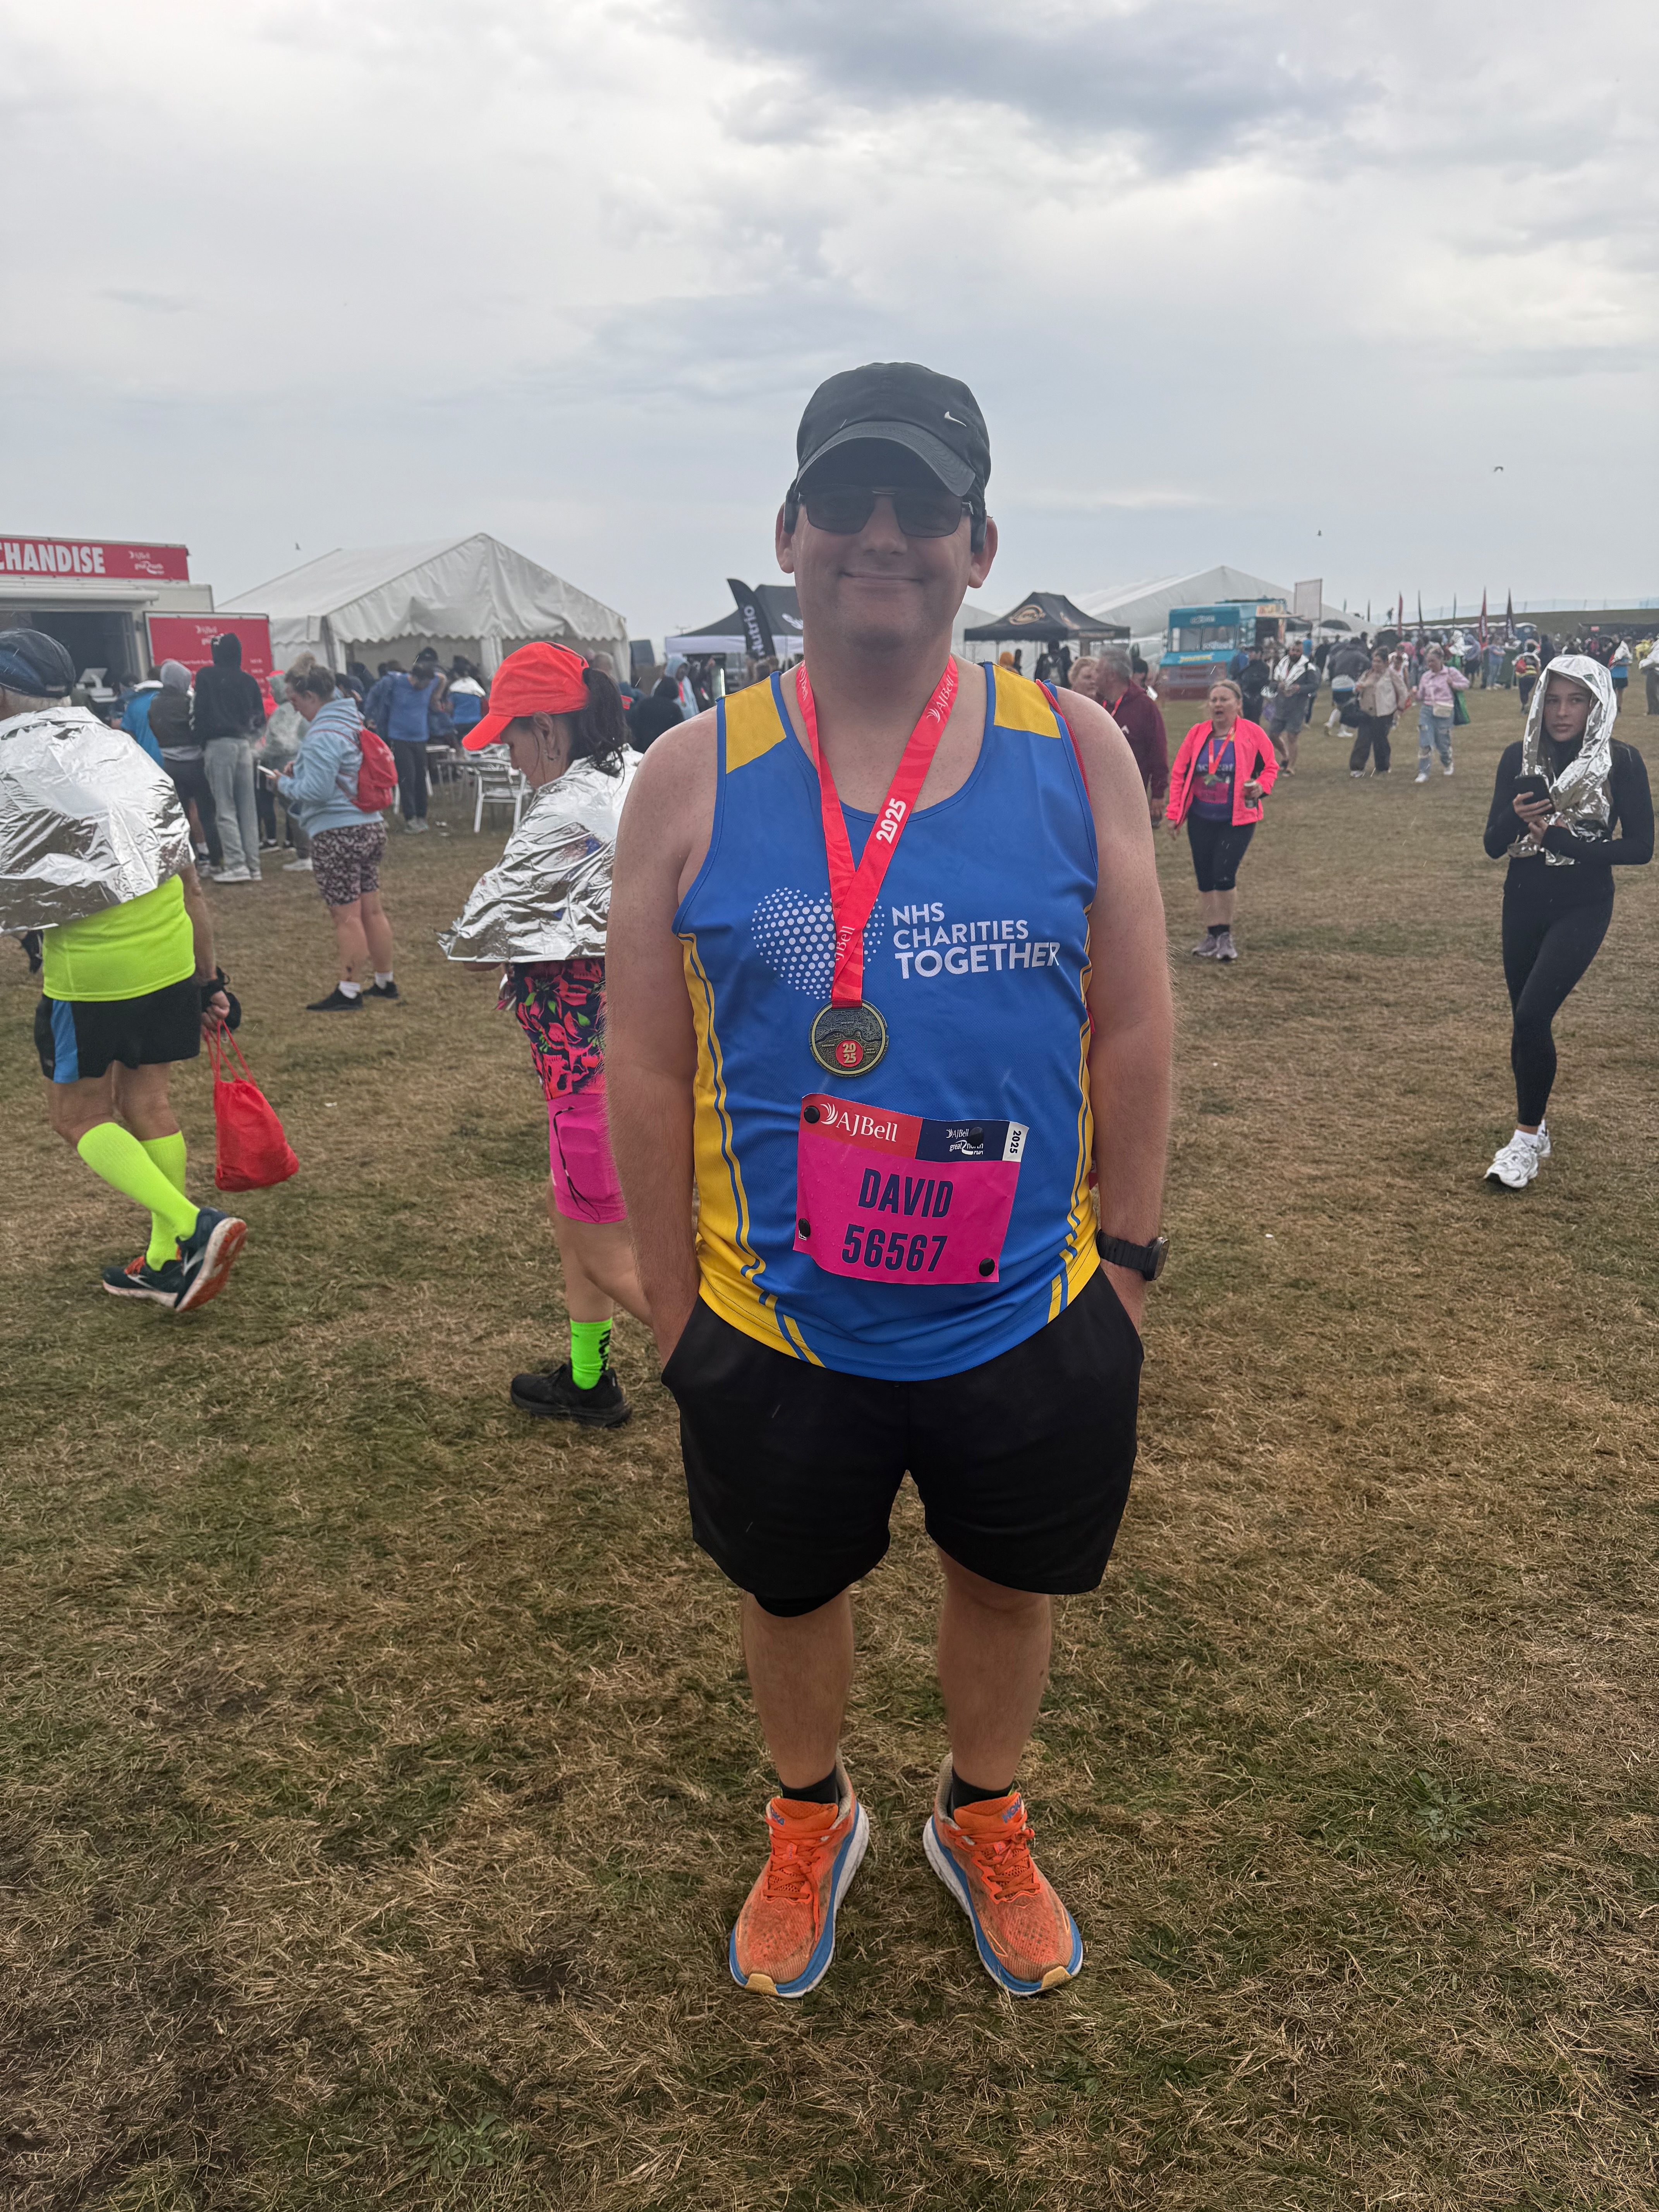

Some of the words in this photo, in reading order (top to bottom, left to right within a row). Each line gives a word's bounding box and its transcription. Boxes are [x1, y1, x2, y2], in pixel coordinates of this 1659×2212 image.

[876, 798, 906, 844] 2025
[892, 902, 945, 926] NHS
[836, 926, 855, 961] JBell
[893, 920, 1029, 949] CHARITIES
[895, 942, 1060, 979] TOGETHER
[842, 1043, 856, 1053] 20
[843, 1053, 856, 1063] 25
[836, 1112, 898, 1142] AJBell
[949, 1142, 962, 1152] great
[1010, 1130, 1022, 1154] 2025
[858, 1168, 953, 1218] DAVID
[842, 1224, 948, 1272] 56567
